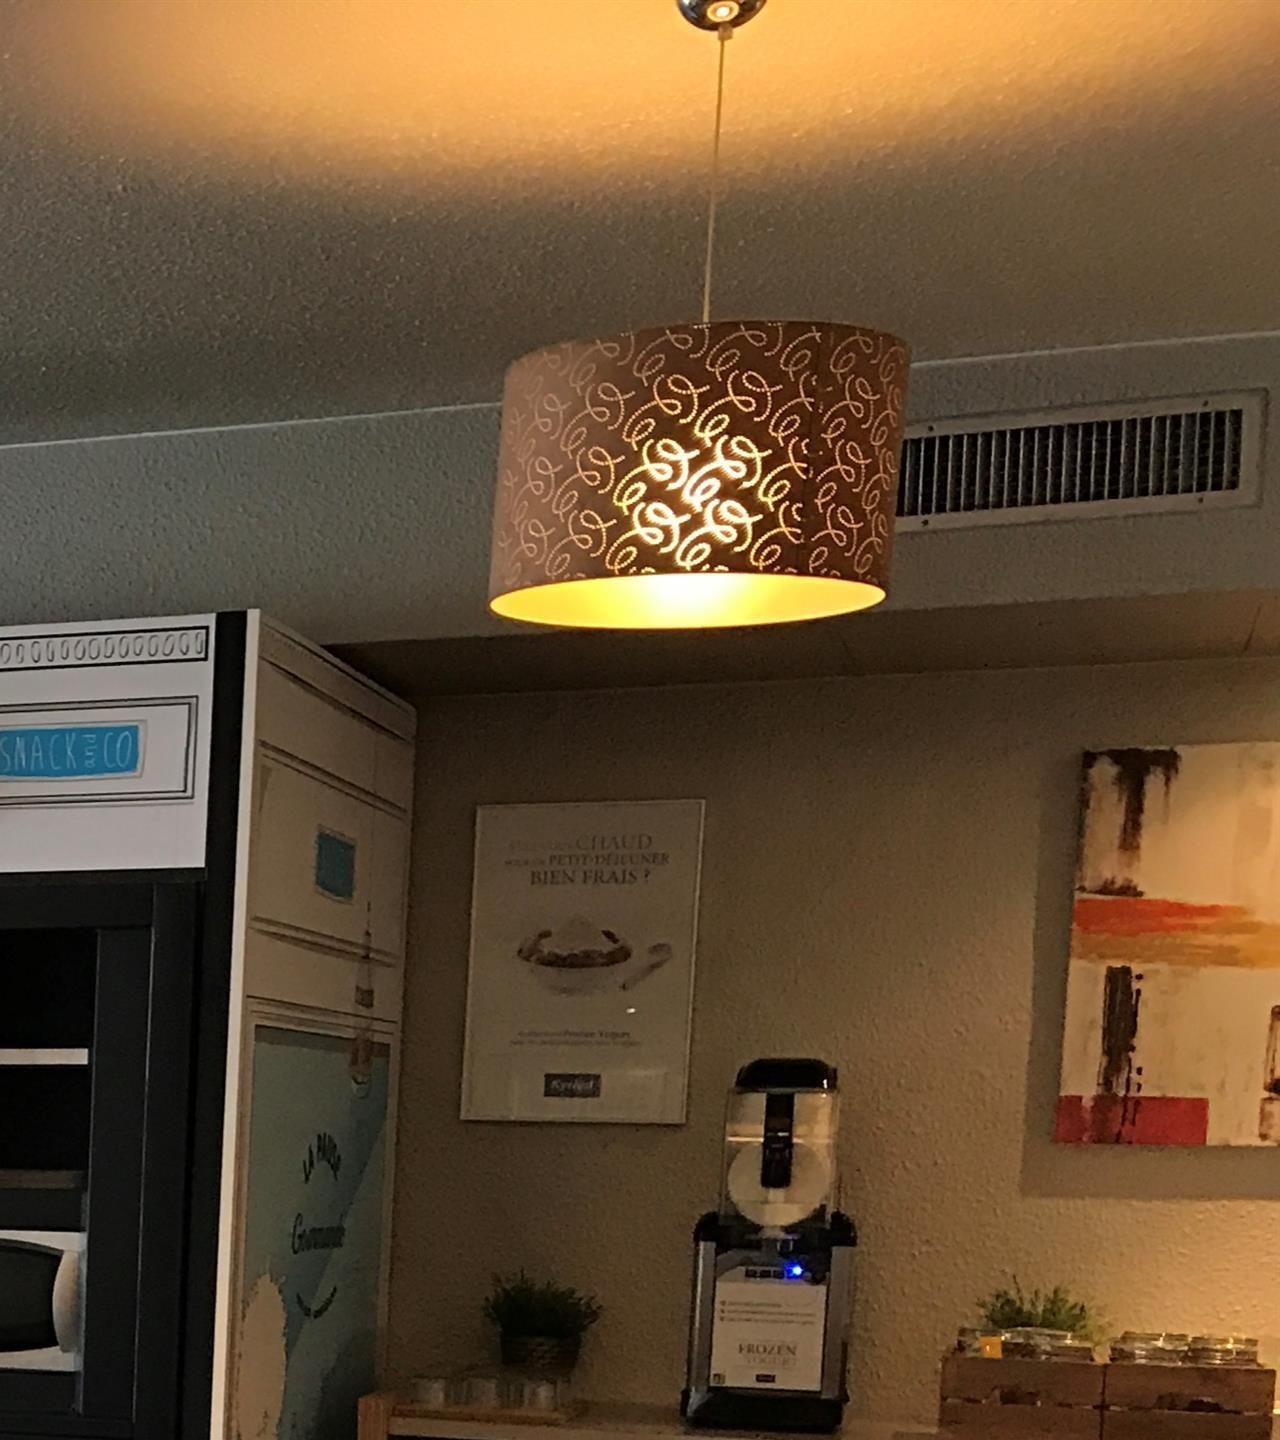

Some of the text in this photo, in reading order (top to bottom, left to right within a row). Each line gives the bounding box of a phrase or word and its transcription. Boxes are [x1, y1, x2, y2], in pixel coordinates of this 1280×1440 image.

[103, 730, 133, 769] CO
[530, 869, 575, 886] BIEN
[582, 867, 638, 885] FRAIS
[738, 1344, 797, 1356] FROZEN
